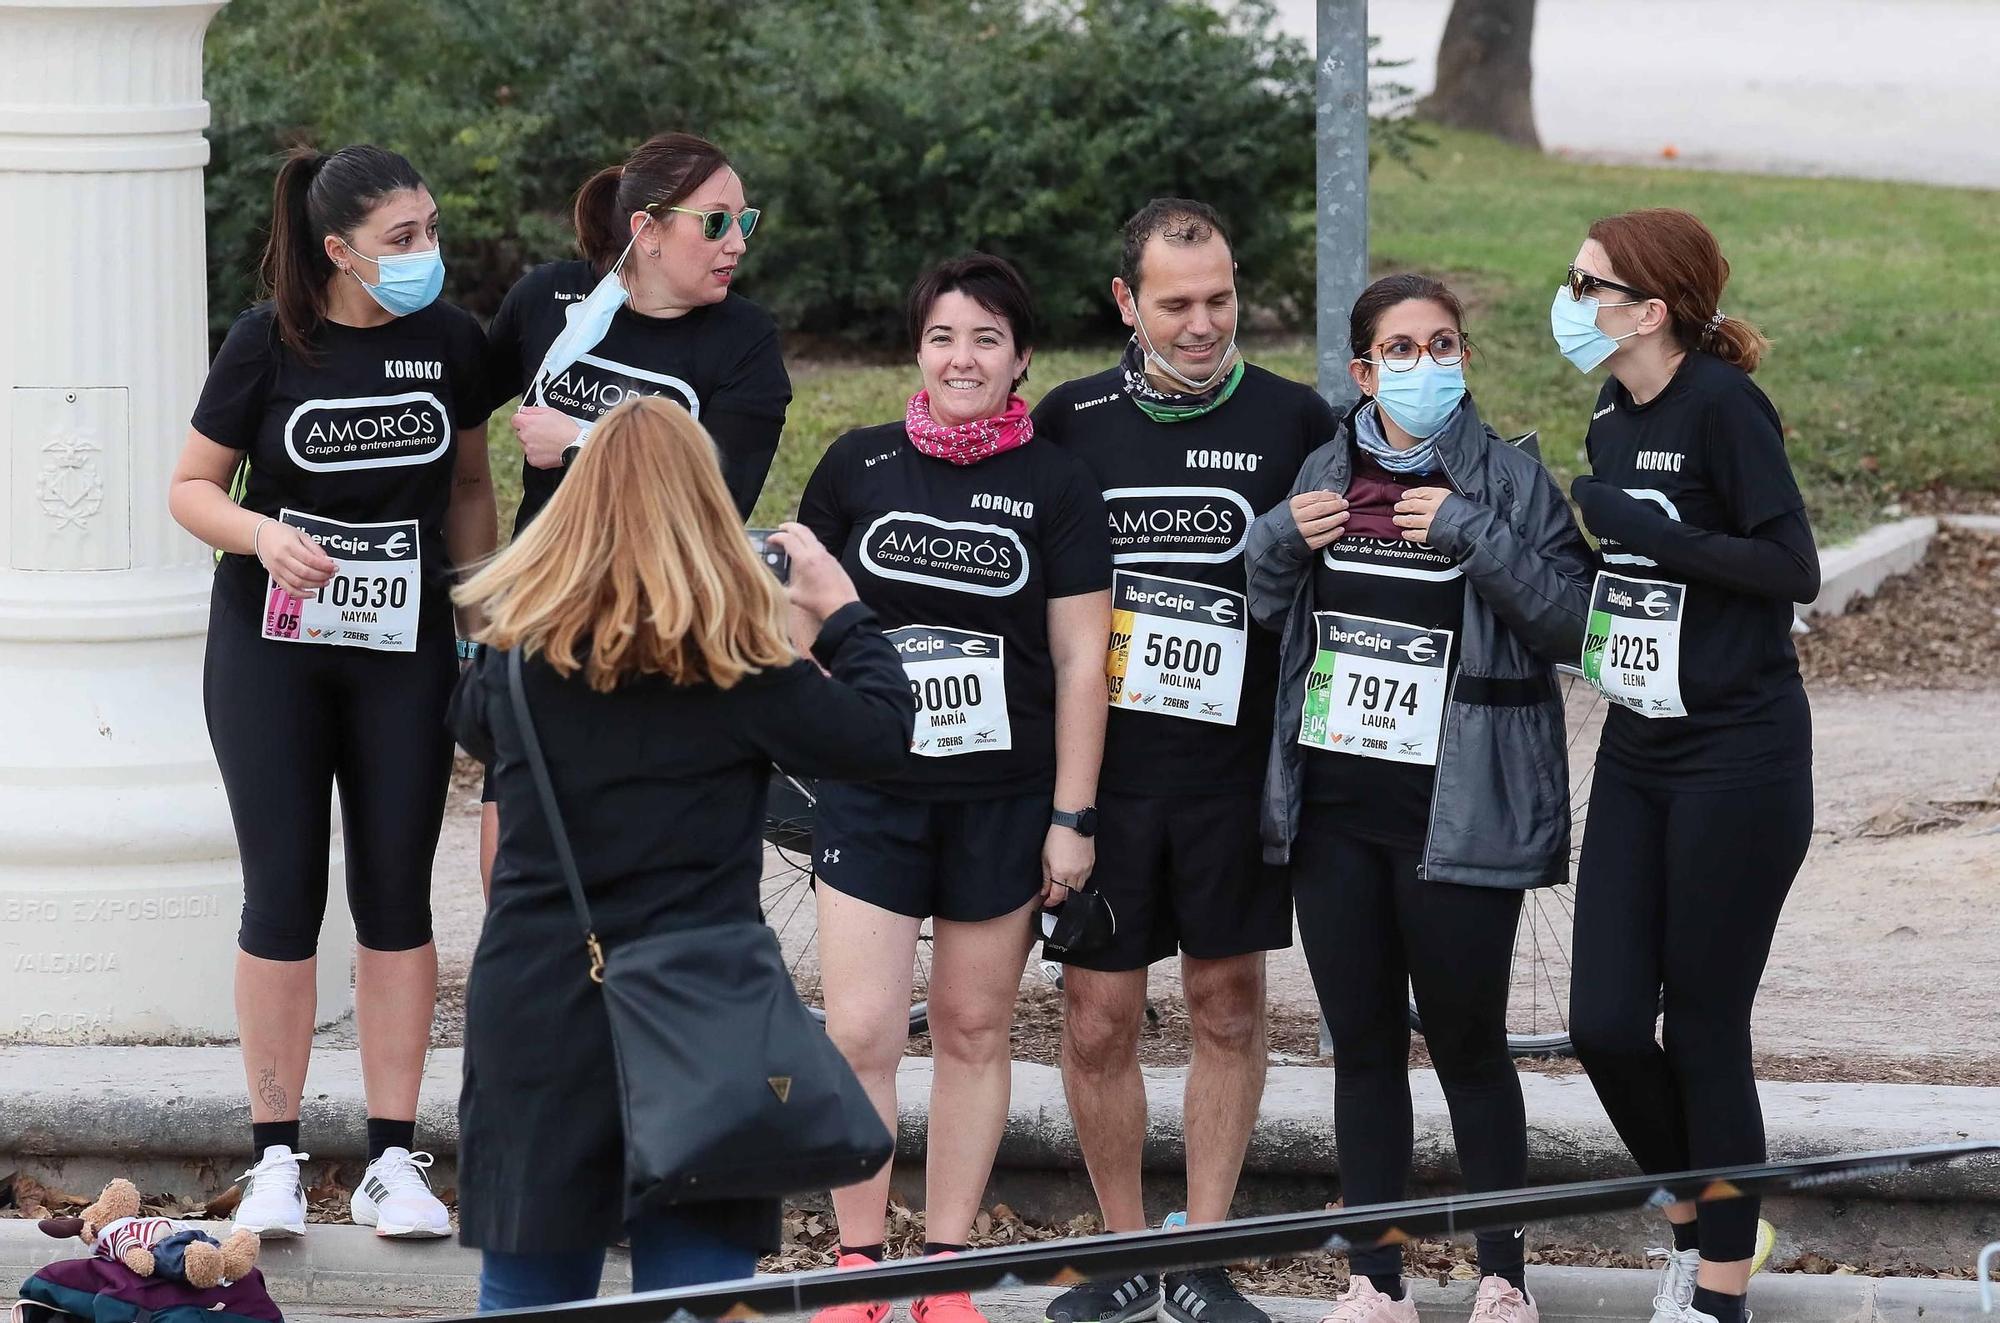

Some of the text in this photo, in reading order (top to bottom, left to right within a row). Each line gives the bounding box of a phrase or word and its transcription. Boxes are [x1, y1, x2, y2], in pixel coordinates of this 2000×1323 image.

[385, 360, 442, 379] KOROKO
[552, 371, 679, 406] AMO
[549, 391, 579, 407] Grupo
[582, 402, 595, 412] de
[1074, 396, 1107, 411] luanvi
[305, 408, 434, 443] AMORÓS
[305, 435, 436, 456] Grupo de entrenamiento
[1186, 449, 1257, 472] KOROKO
[1636, 450, 1682, 472] KOROKO
[971, 493, 1034, 519] KOROKO
[1108, 504, 1233, 534] AMORÓS
[297, 526, 369, 554] erCaja
[879, 531, 1011, 569] AMORÓS
[1110, 533, 1231, 547] rupo de entrenamiento
[1333, 543, 1357, 553] Grupo
[1359, 545, 1372, 554] de
[1374, 548, 1451, 564] entrenamiento
[877, 550, 1010, 580] Grupo de entrenamiento
[317, 576, 407, 609] 10530
[1126, 586, 1195, 613] iberCaja
[1607, 587, 1632, 611] iberCaja
[278, 613, 299, 630] 05
[341, 611, 378, 623] NAYMA
[343, 630, 369, 641] 226ERS
[893, 636, 944, 654] rCaja
[1108, 632, 1131, 651] 10K
[1329, 626, 1392, 653] iberCaja
[1585, 633, 1608, 653] 10K
[1144, 633, 1222, 676] 5600
[1611, 633, 1659, 672] 9225
[1110, 676, 1123, 694] 03
[1160, 672, 1201, 691] MOLINA
[1307, 672, 1333, 691] 10K
[1623, 673, 1646, 687] ELENA
[1163, 696, 1189, 709] 226ERS
[1347, 673, 1418, 716] 7974
[930, 710, 967, 728] MARÍA
[1311, 715, 1325, 735] 04
[1362, 713, 1396, 731] LAURA
[937, 736, 963, 748] 226ERS
[1362, 738, 1388, 750] 226ERS
[0, 899, 58, 922] BRO
[14, 952, 120, 974] VALENCIA
